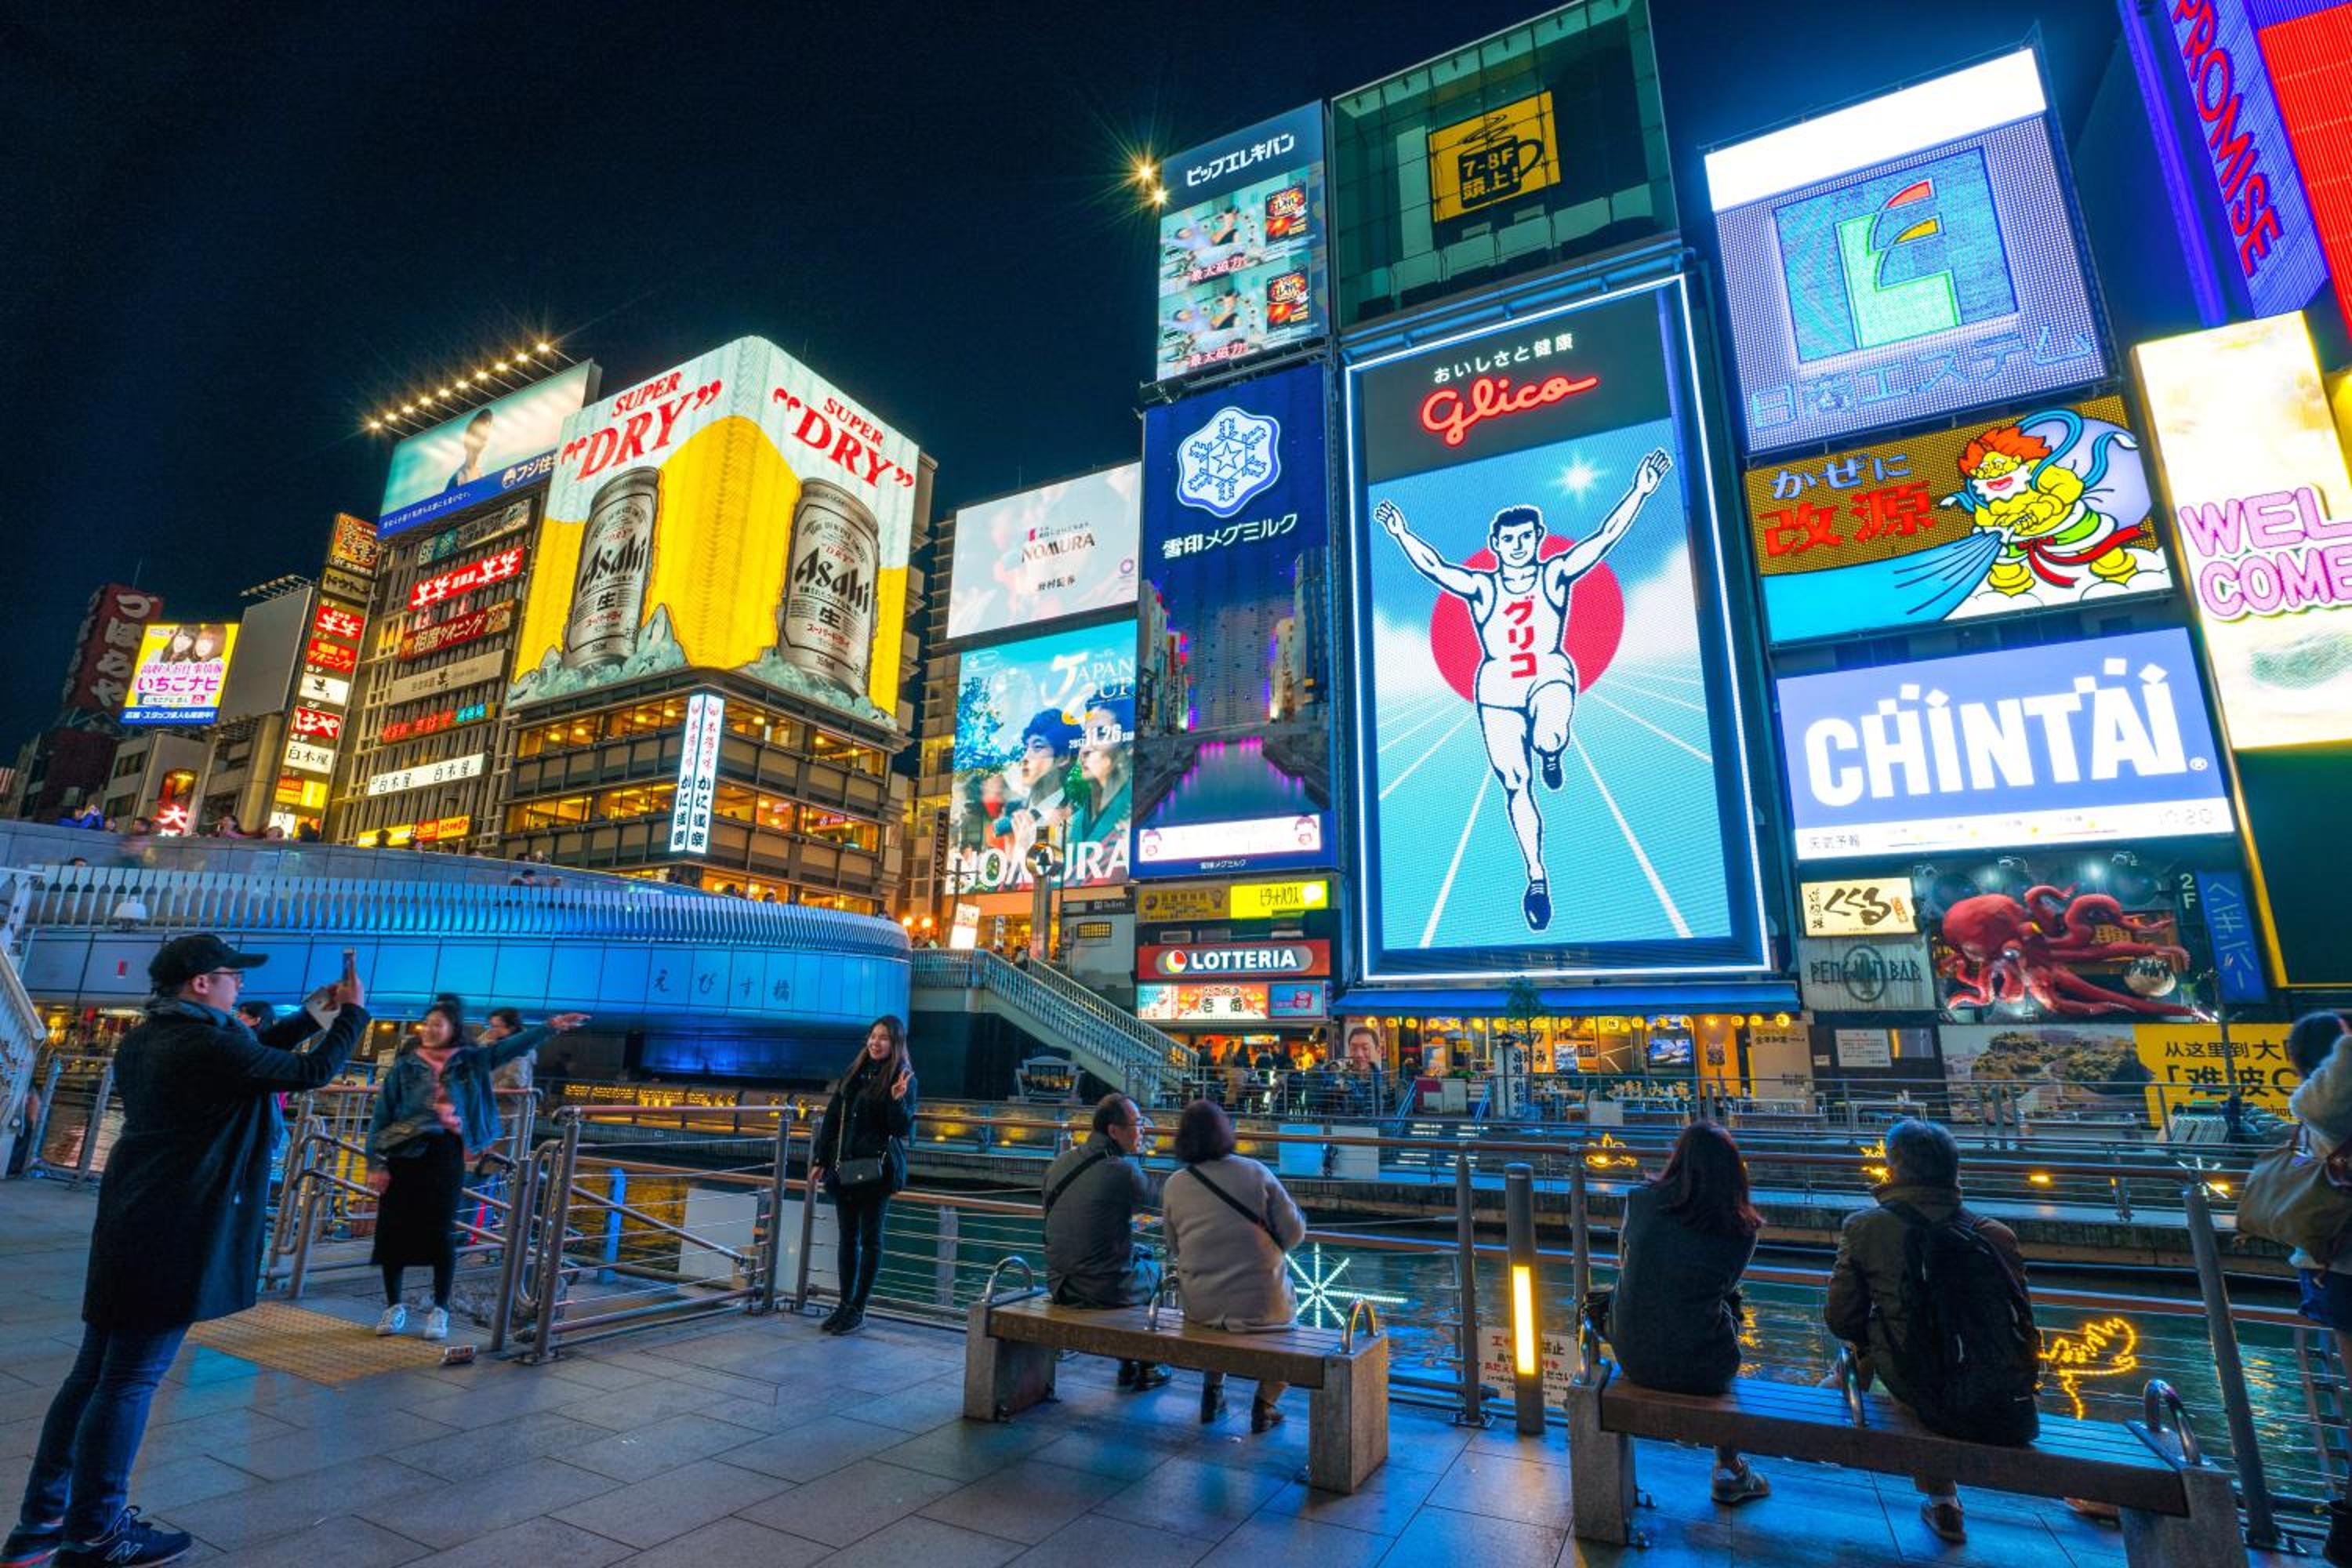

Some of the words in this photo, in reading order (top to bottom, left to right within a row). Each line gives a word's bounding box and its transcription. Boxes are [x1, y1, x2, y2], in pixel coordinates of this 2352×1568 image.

[1186, 133, 1294, 186] ピップエレキバン
[1434, 333, 1573, 384] おいしさと健康
[612, 372, 682, 417] SUPER
[1421, 376, 1598, 445] Glico
[824, 397, 884, 447] SUPER
[517, 455, 557, 483] フジ住
[1770, 452, 1912, 500] かぜに
[1162, 513, 1298, 559] 雪印メグミルク
[1759, 481, 1940, 557] 改源
[2180, 487, 2352, 557] WEL
[579, 533, 647, 592] Asahi
[1022, 532, 1095, 563] NOMURA
[597, 592, 616, 611] 生
[795, 547, 870, 613] Asahi
[2201, 545, 2352, 616] COME
[819, 607, 841, 630] 生
[1504, 595, 1537, 679] グリコ
[288, 746, 329, 766] 白木屋
[1259, 887, 1299, 906] ピタットハウス
[1192, 949, 1298, 970] LOTTERIA
[2207, 882, 2253, 990] ペンギンバー
[653, 969, 791, 1003] えびす橋
[1889, 959, 1922, 982] BAR
